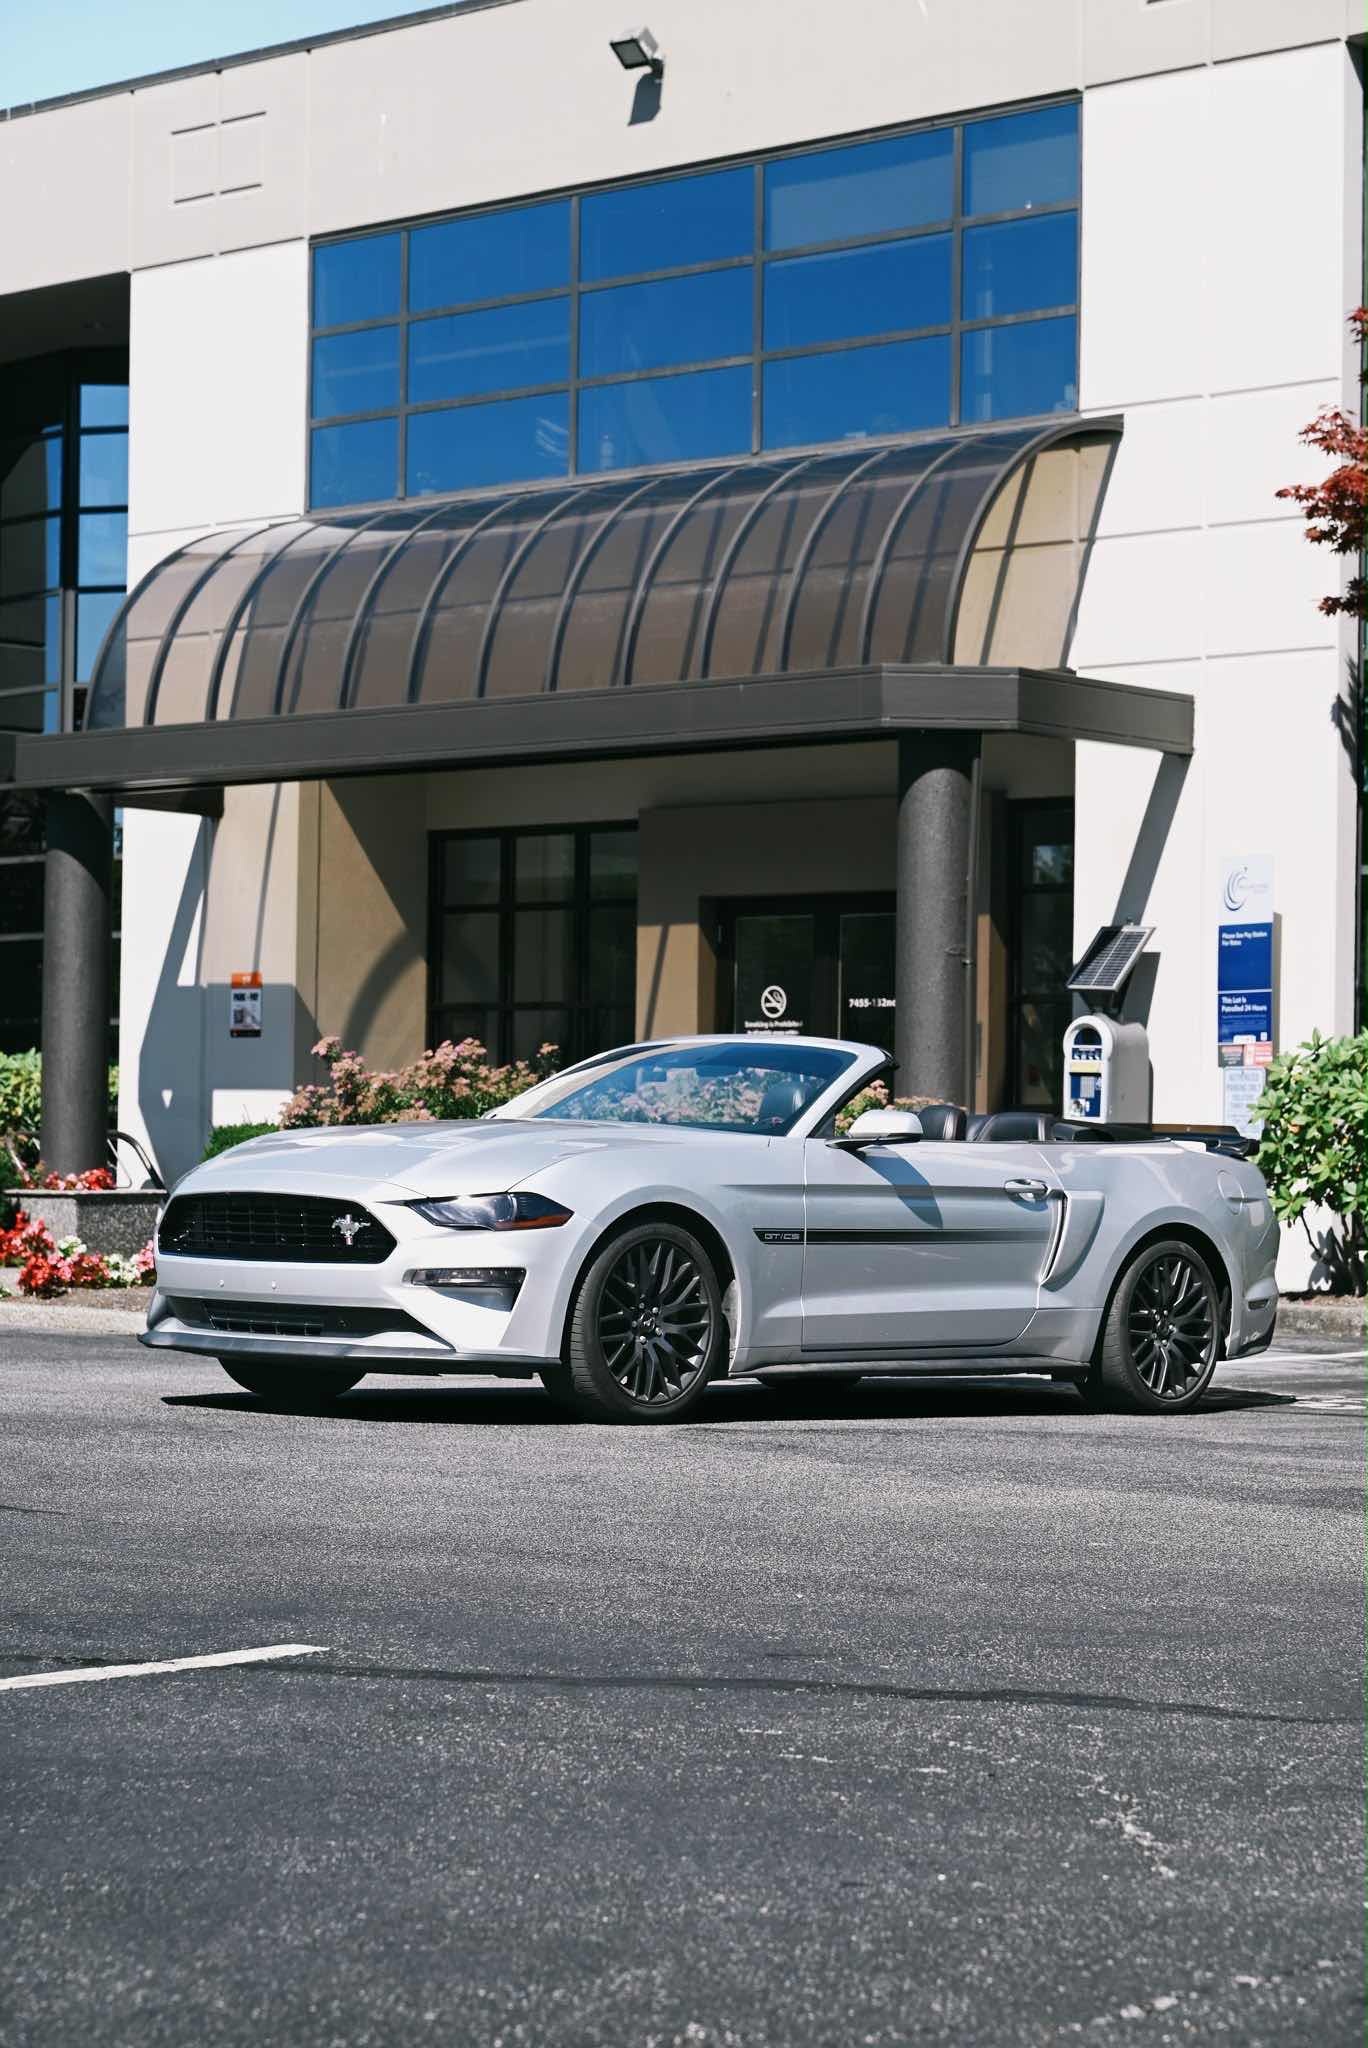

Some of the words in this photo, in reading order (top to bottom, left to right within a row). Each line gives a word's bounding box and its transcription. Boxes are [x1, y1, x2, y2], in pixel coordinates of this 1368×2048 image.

[1222, 996, 1232, 1004] This
[1232, 996, 1241, 1004] Lot
[1222, 1004, 1243, 1012] Patrolled
[1244, 1004, 1251, 1012] 24
[1252, 1003, 1267, 1011] Hours
[744, 1020, 768, 1029] Smoking
